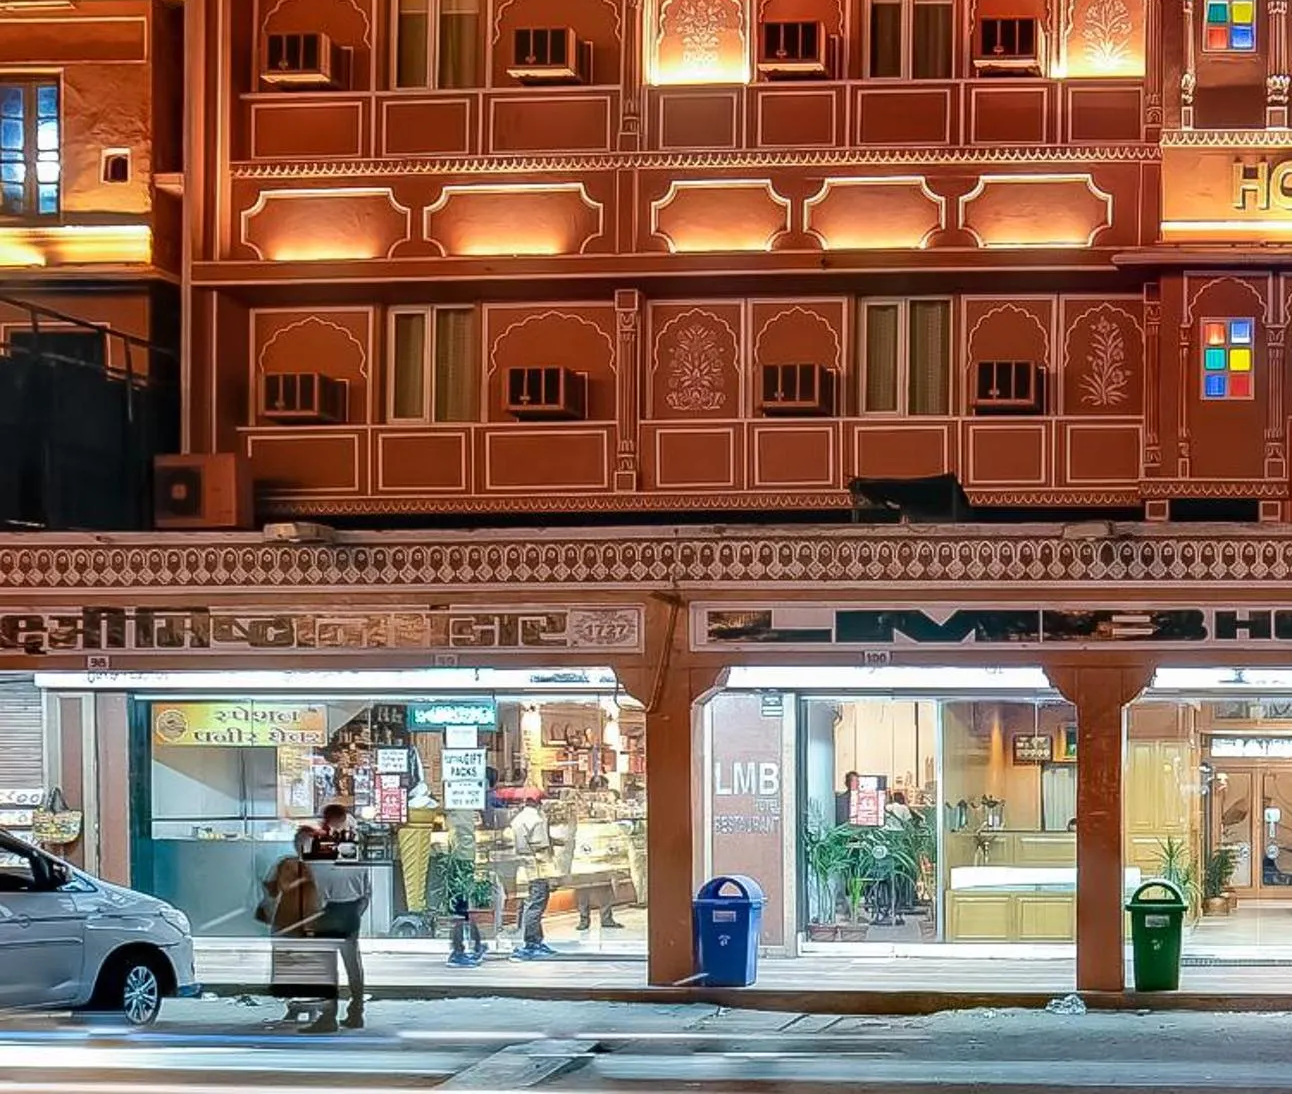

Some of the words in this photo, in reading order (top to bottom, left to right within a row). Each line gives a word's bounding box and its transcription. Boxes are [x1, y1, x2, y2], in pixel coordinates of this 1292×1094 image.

[584, 622, 629, 641] 1727
[704, 609, 1209, 644] LMB
[714, 761, 780, 796] LMB
